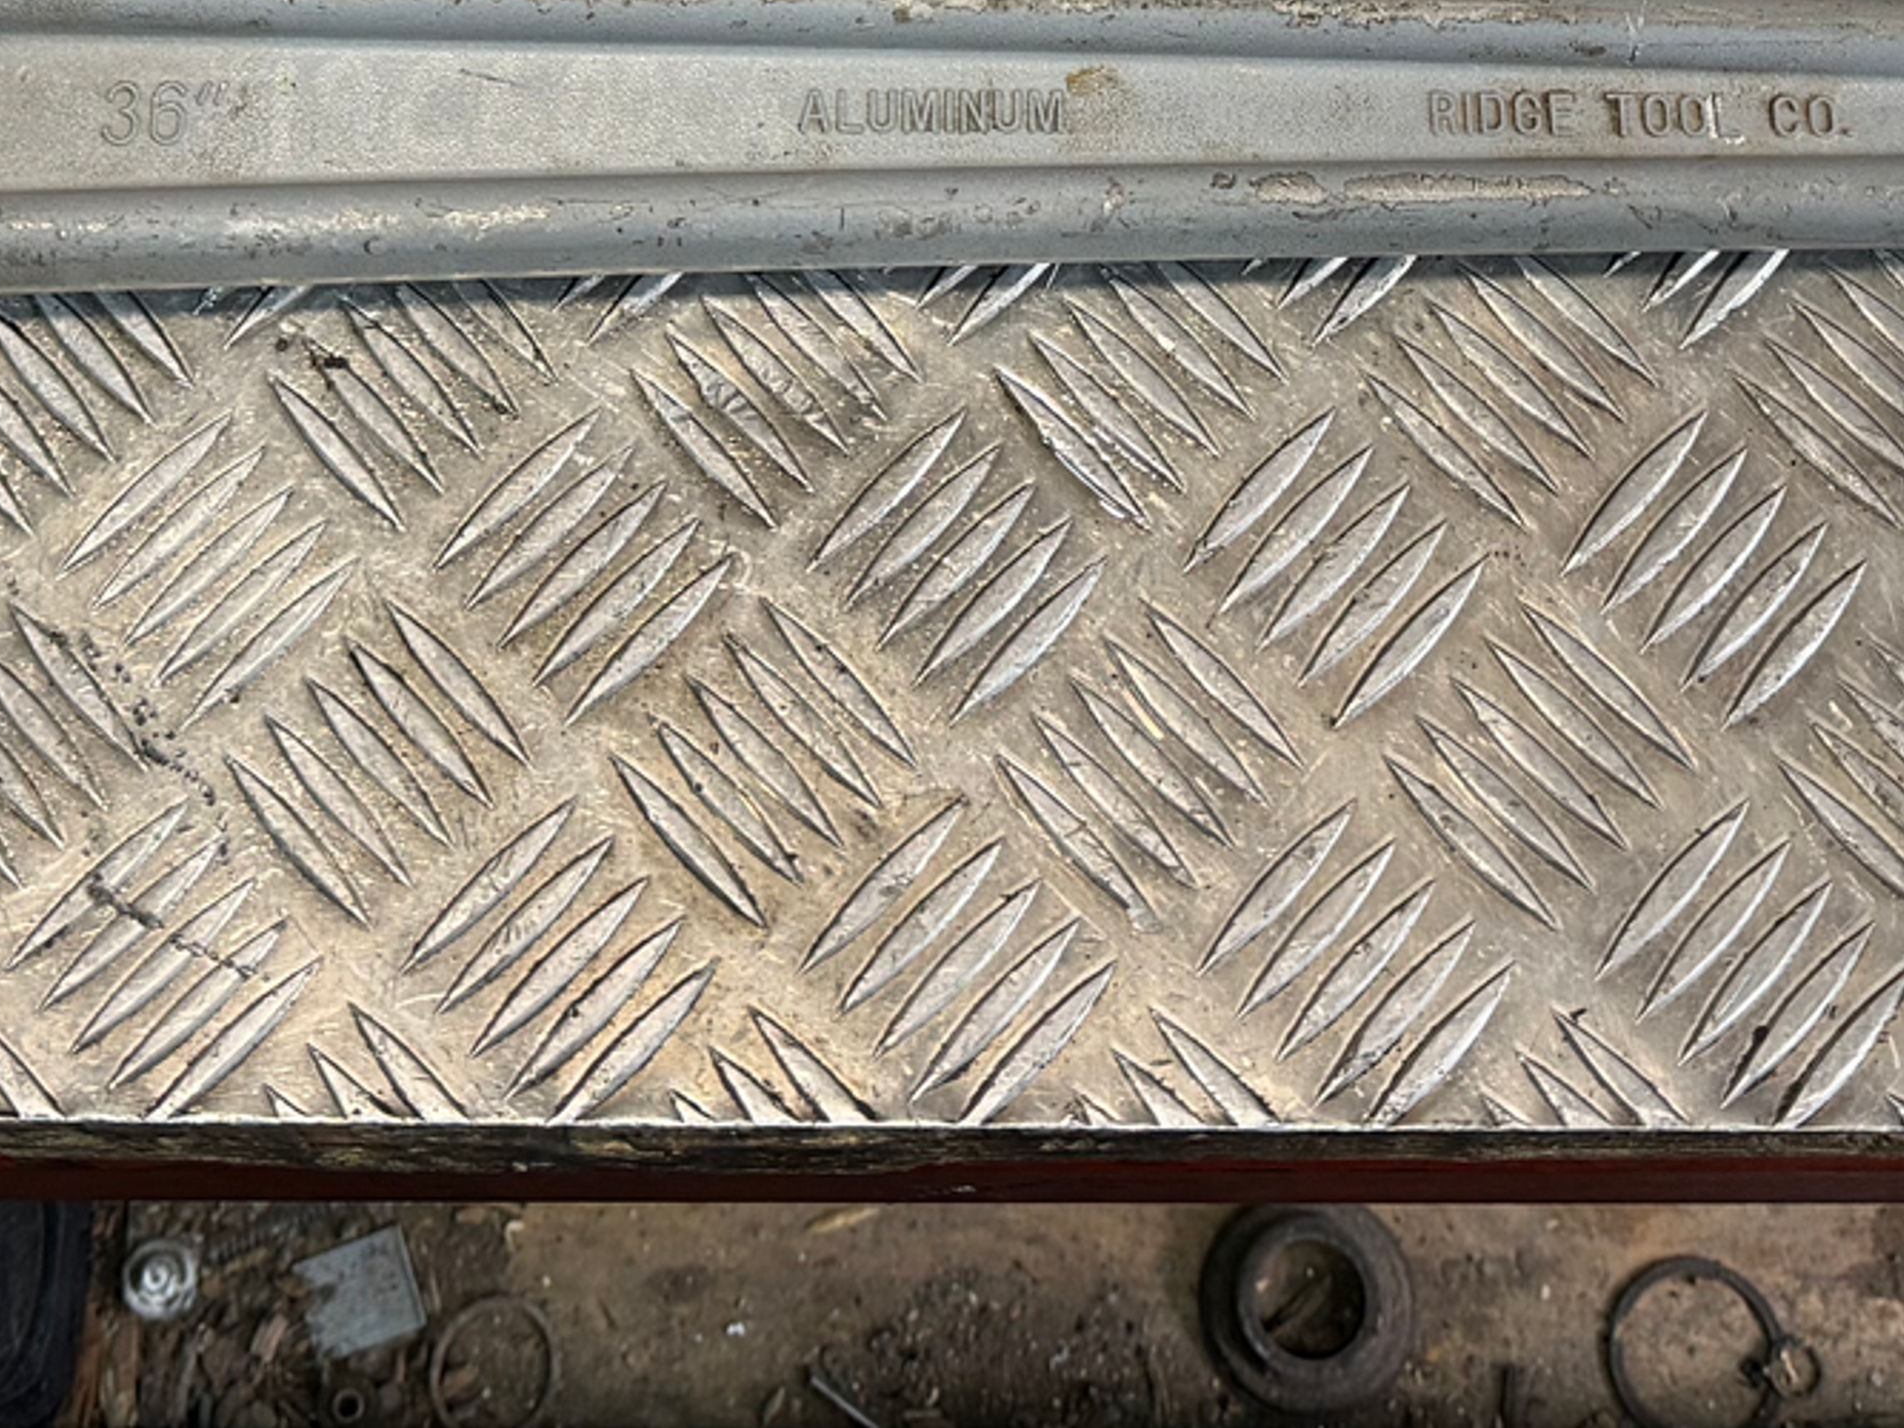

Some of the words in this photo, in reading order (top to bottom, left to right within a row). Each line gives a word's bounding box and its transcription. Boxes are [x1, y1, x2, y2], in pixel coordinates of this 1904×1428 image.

[100, 78, 232, 148] 36"
[797, 87, 1068, 138] ALUMINUM
[1426, 87, 1576, 137] RIDGE
[1604, 89, 1746, 142] TOOL
[1767, 91, 1857, 140] CO.
